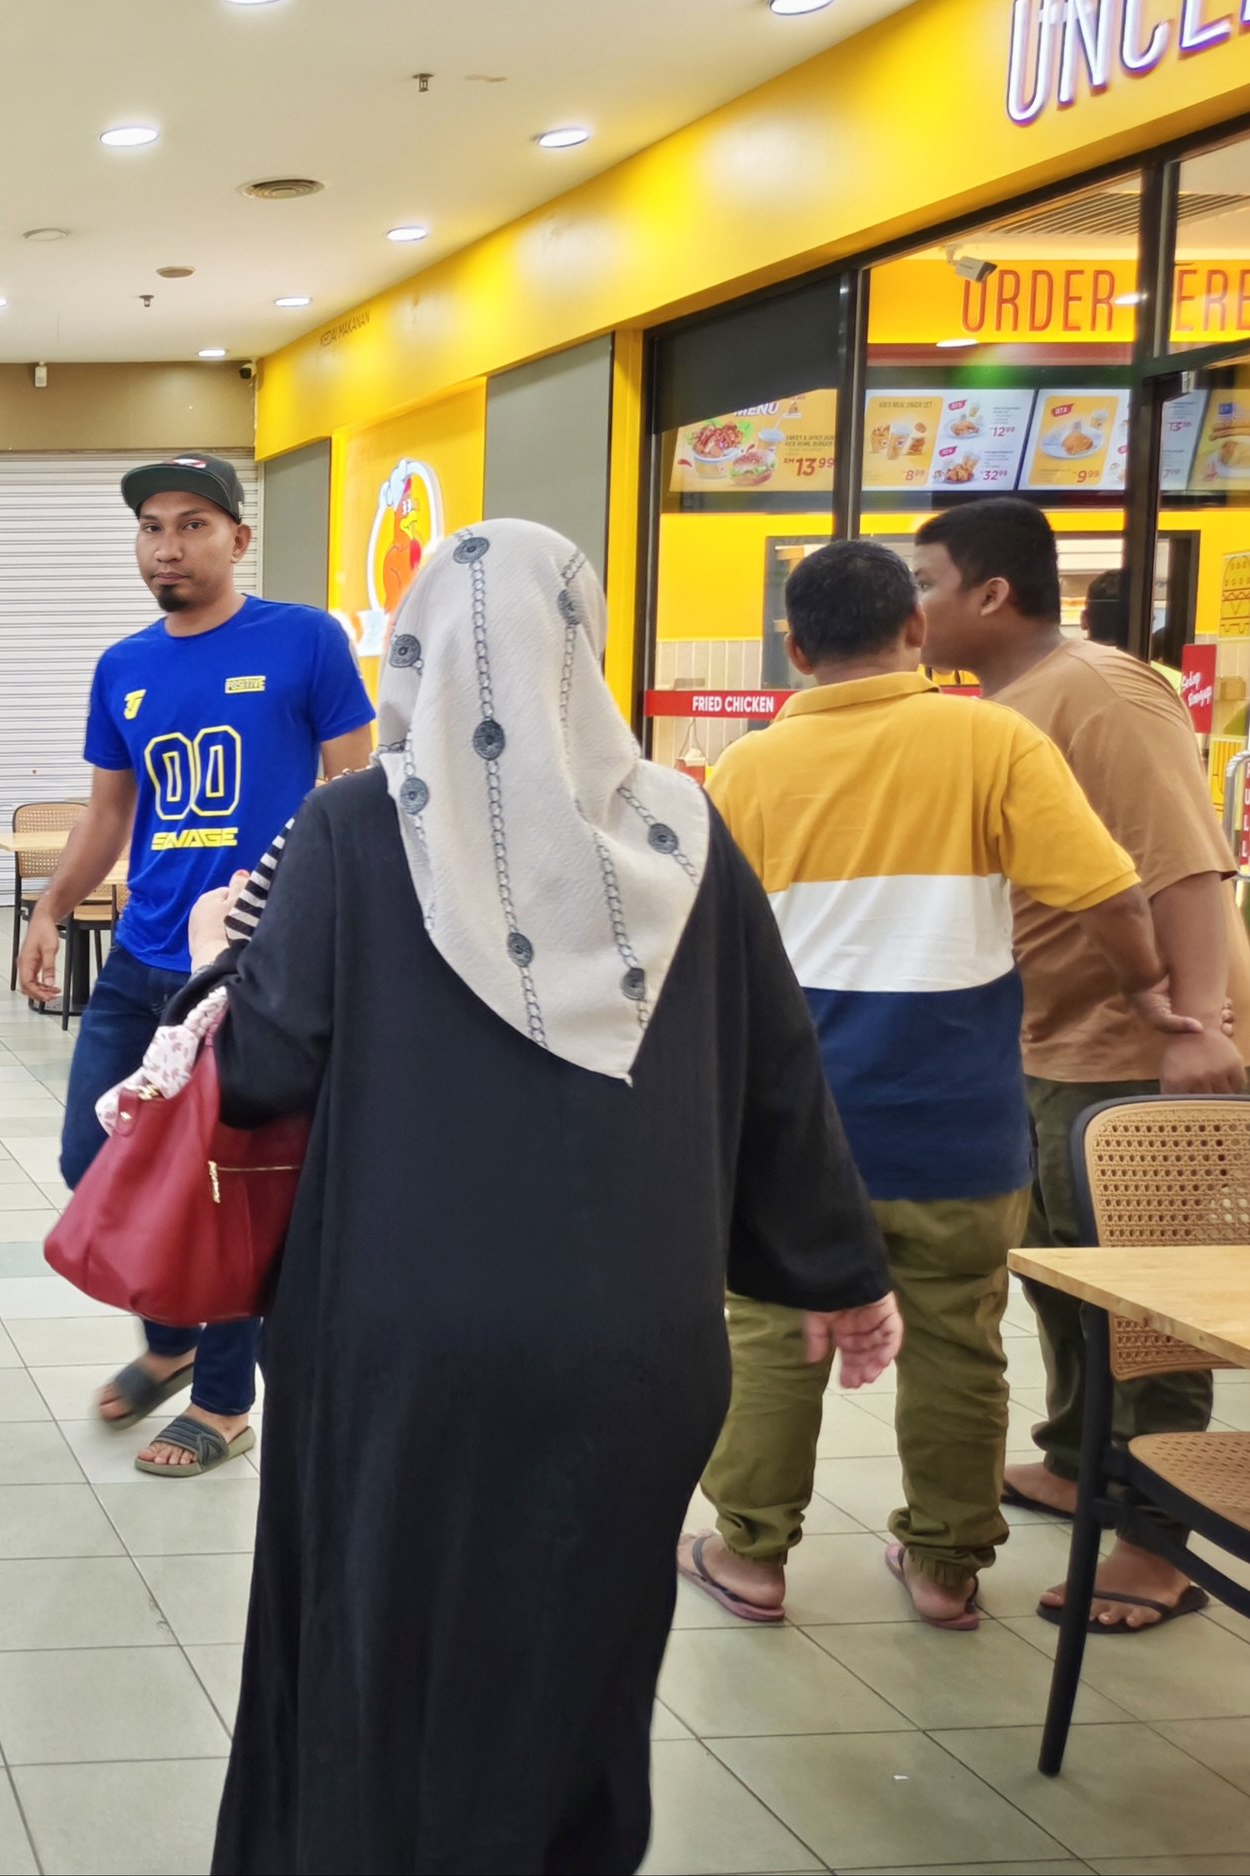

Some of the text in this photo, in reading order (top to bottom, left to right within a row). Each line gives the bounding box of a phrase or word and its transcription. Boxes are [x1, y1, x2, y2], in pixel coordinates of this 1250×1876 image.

[1007, 0, 1250, 126] UNC
[961, 269, 1250, 333] ORDER ERE
[692, 695, 774, 713] FRIED CHICKEN
[144, 725, 241, 820] 00
